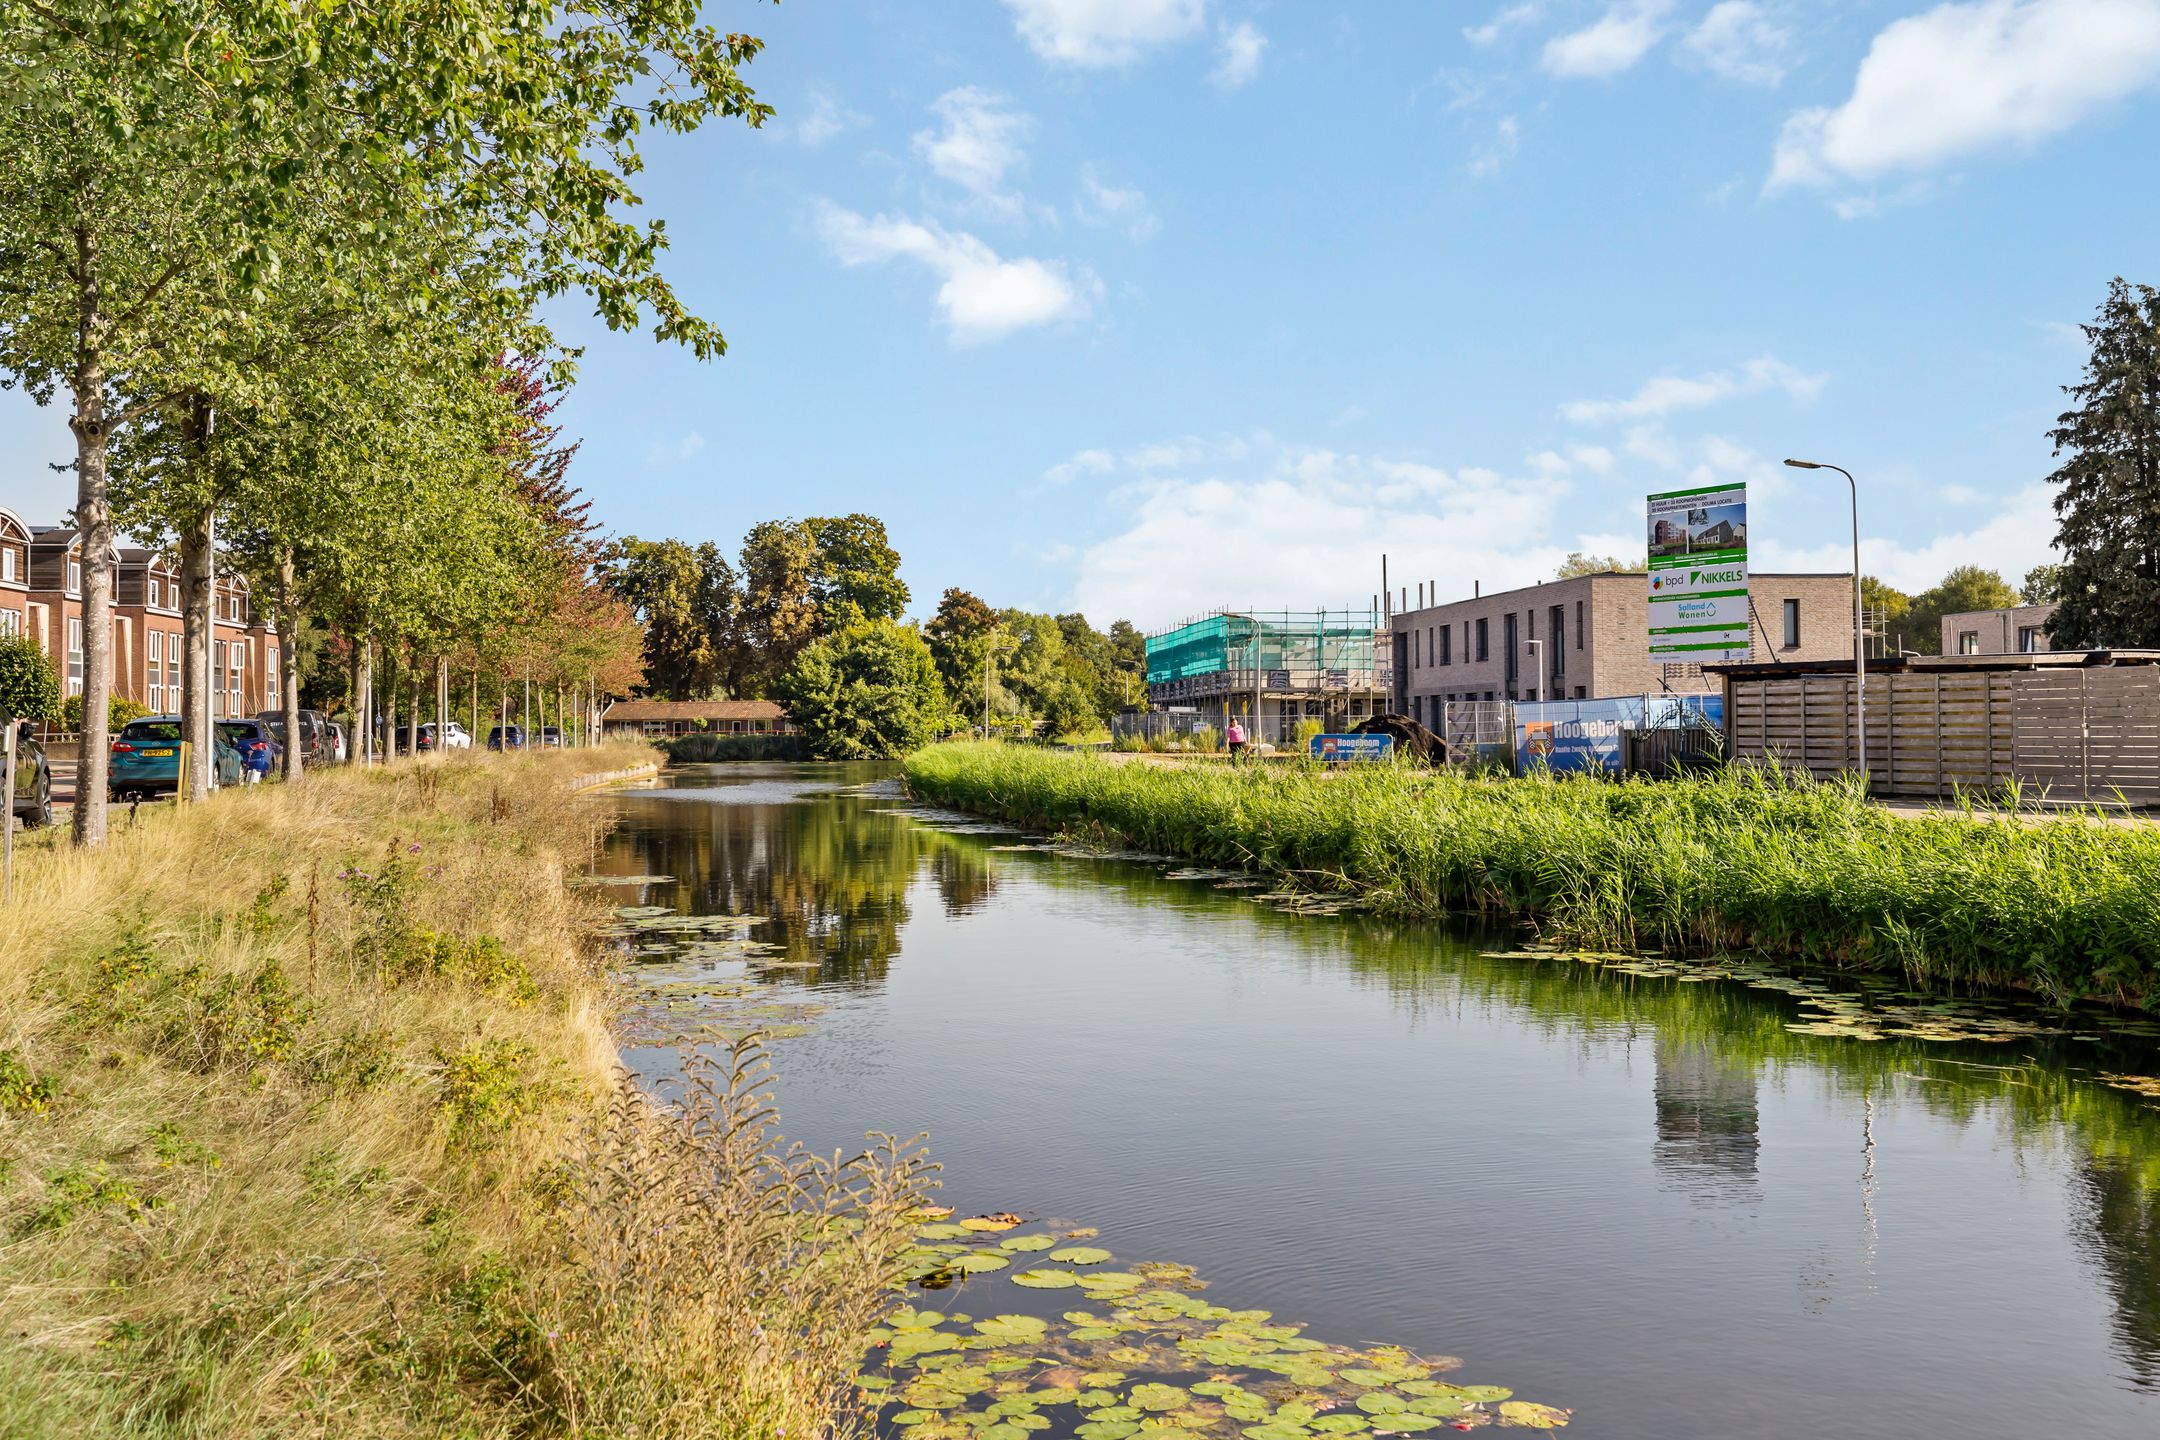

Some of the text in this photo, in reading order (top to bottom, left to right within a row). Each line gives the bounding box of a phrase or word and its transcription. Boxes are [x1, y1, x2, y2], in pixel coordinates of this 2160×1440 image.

[1665, 574, 1684, 588] bpd
[1701, 570, 1743, 584] NIKKELS
[1678, 602, 1706, 611] Salland
[1678, 611, 1706, 619] Wonen
